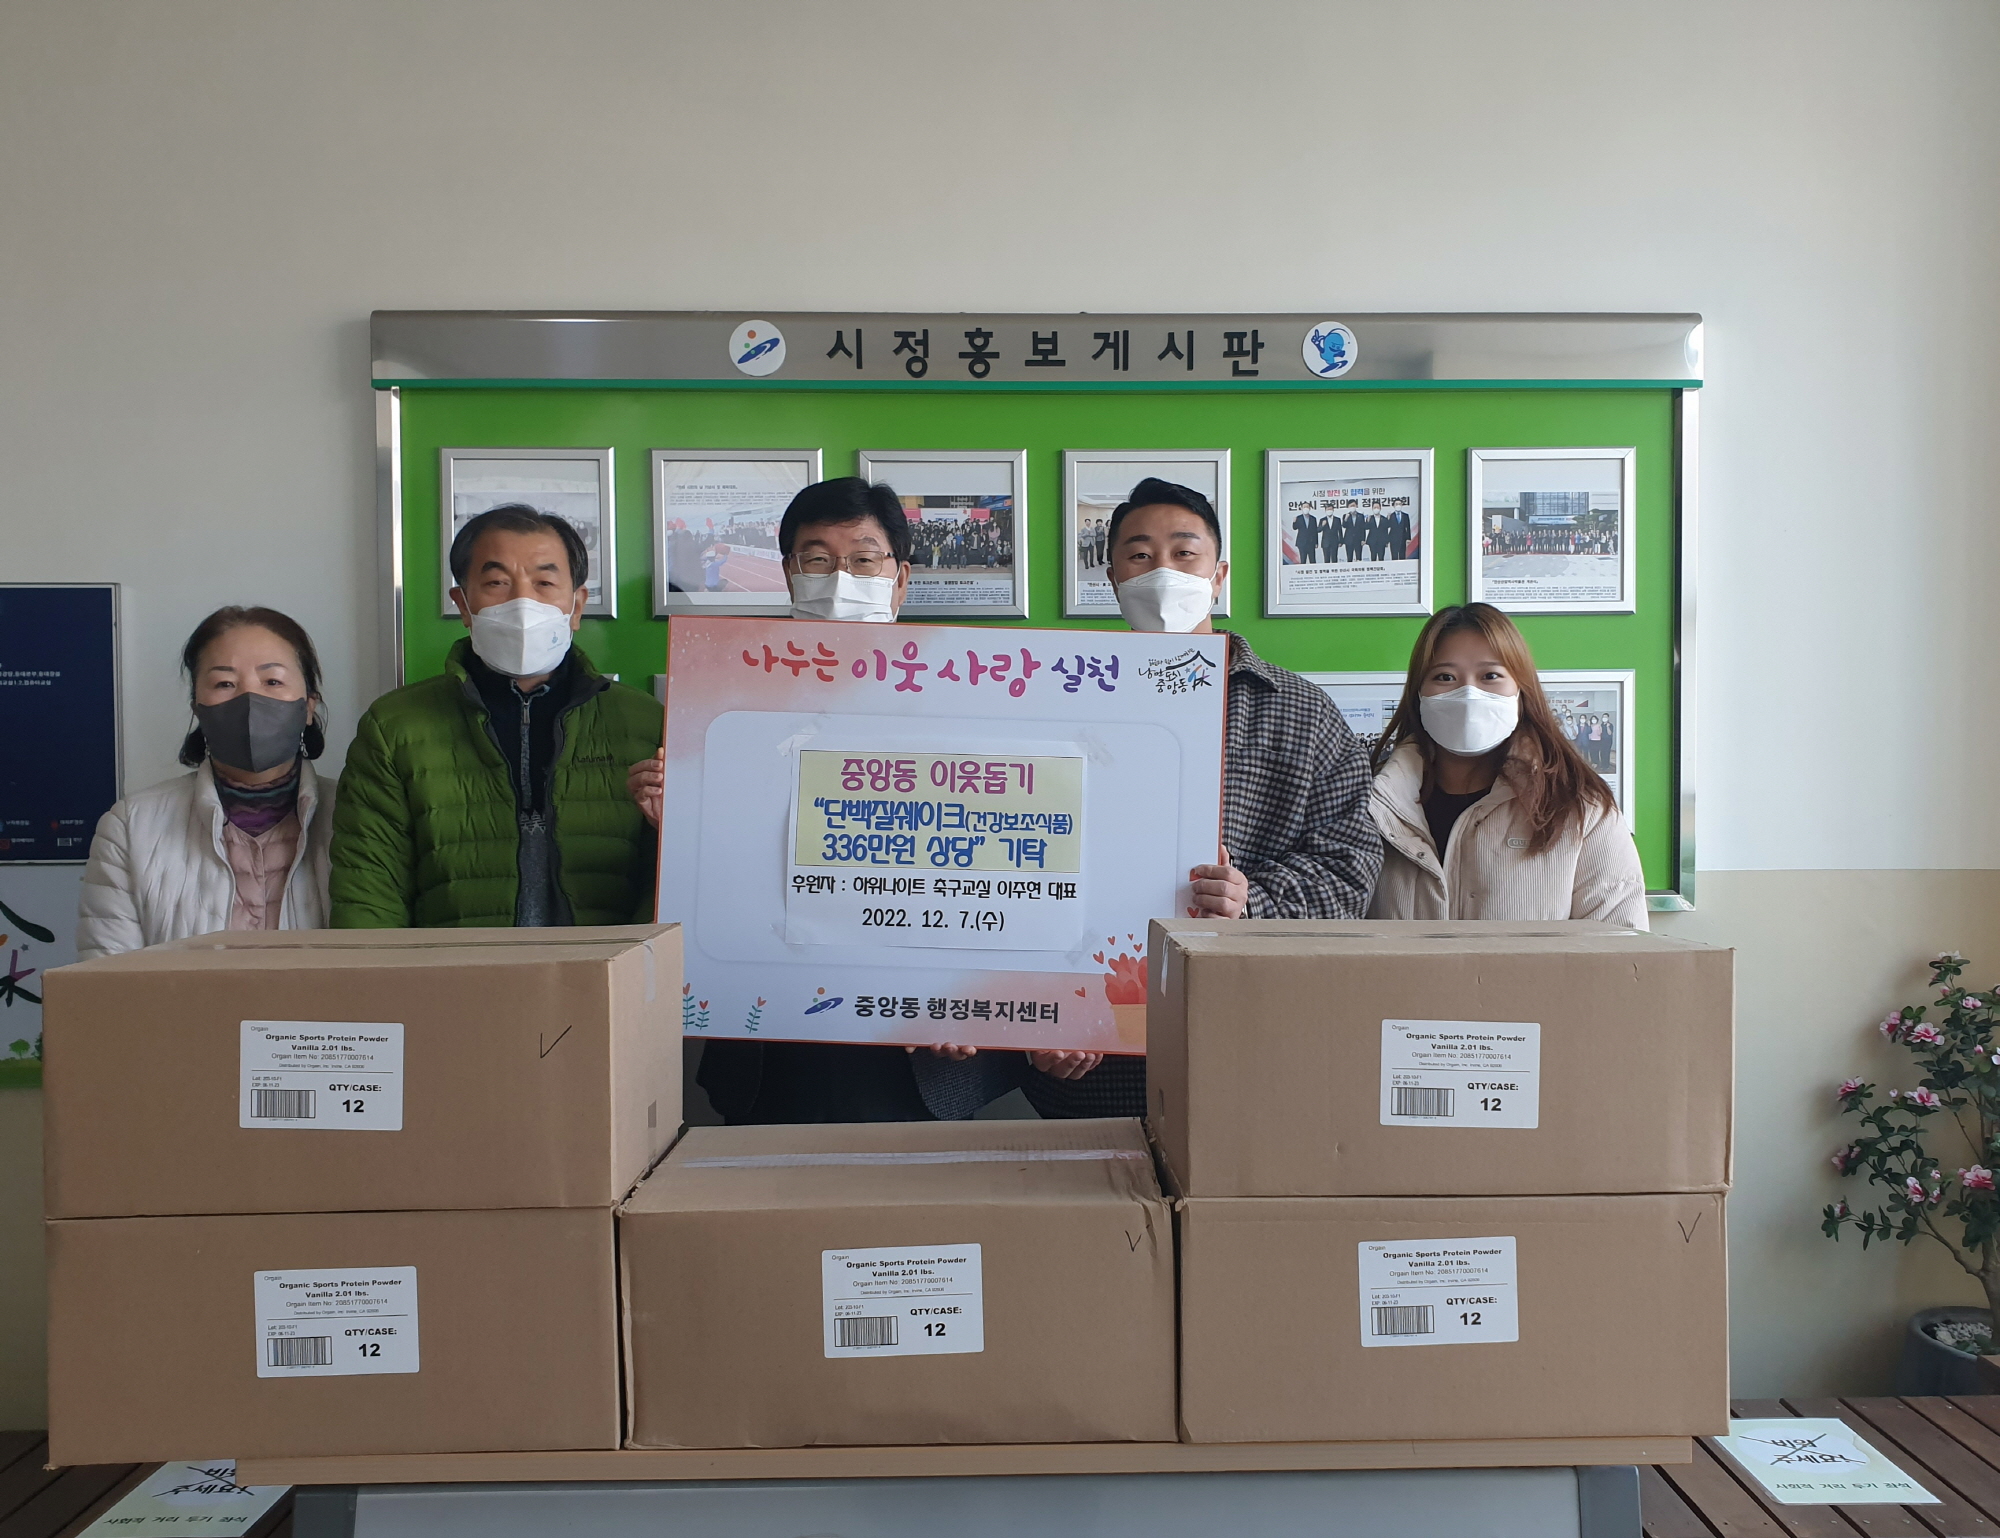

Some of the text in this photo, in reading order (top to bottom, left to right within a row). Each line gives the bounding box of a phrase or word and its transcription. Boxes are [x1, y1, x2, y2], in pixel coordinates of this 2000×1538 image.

[742, 641, 1119, 697] 나누는 이웃 사랑 실천
[1155, 678, 1188, 695] 중앙동
[841, 759, 1034, 794] 중앙동 이웃돕기
[822, 834, 1047, 868] 336만원 상당” 기탁
[792, 875, 835, 894] 후원자
[933, 878, 990, 898] 축구교실
[997, 880, 1041, 899] 이주현
[1048, 881, 1077, 900] 대표
[862, 908, 912, 927] 2022.
[922, 910, 948, 928] 12.
[854, 996, 1059, 1023] 중앙동 행정복지센터
[1467, 1082, 1518, 1090] QTY/CASE:
[342, 1099, 364, 1112] 12
[1480, 1097, 1501, 1111] 12
[1383, 1251, 1413, 1259] Organic
[846, 1261, 876, 1269] Organic
[1446, 1296, 1497, 1305] QTY/CASE:
[910, 1306, 961, 1316] QTY/CASE:
[1459, 1312, 1481, 1325] 12
[344, 1327, 396, 1336] QTY/CASE:
[923, 1322, 946, 1336] 12
[358, 1343, 380, 1356] 12
[1776, 1482, 1913, 1490] 사회적 거리 두기 좌석
[103, 1516, 148, 1524] 사회적
[185, 1516, 214, 1524] 두기
[218, 1516, 248, 1524] 좌석
